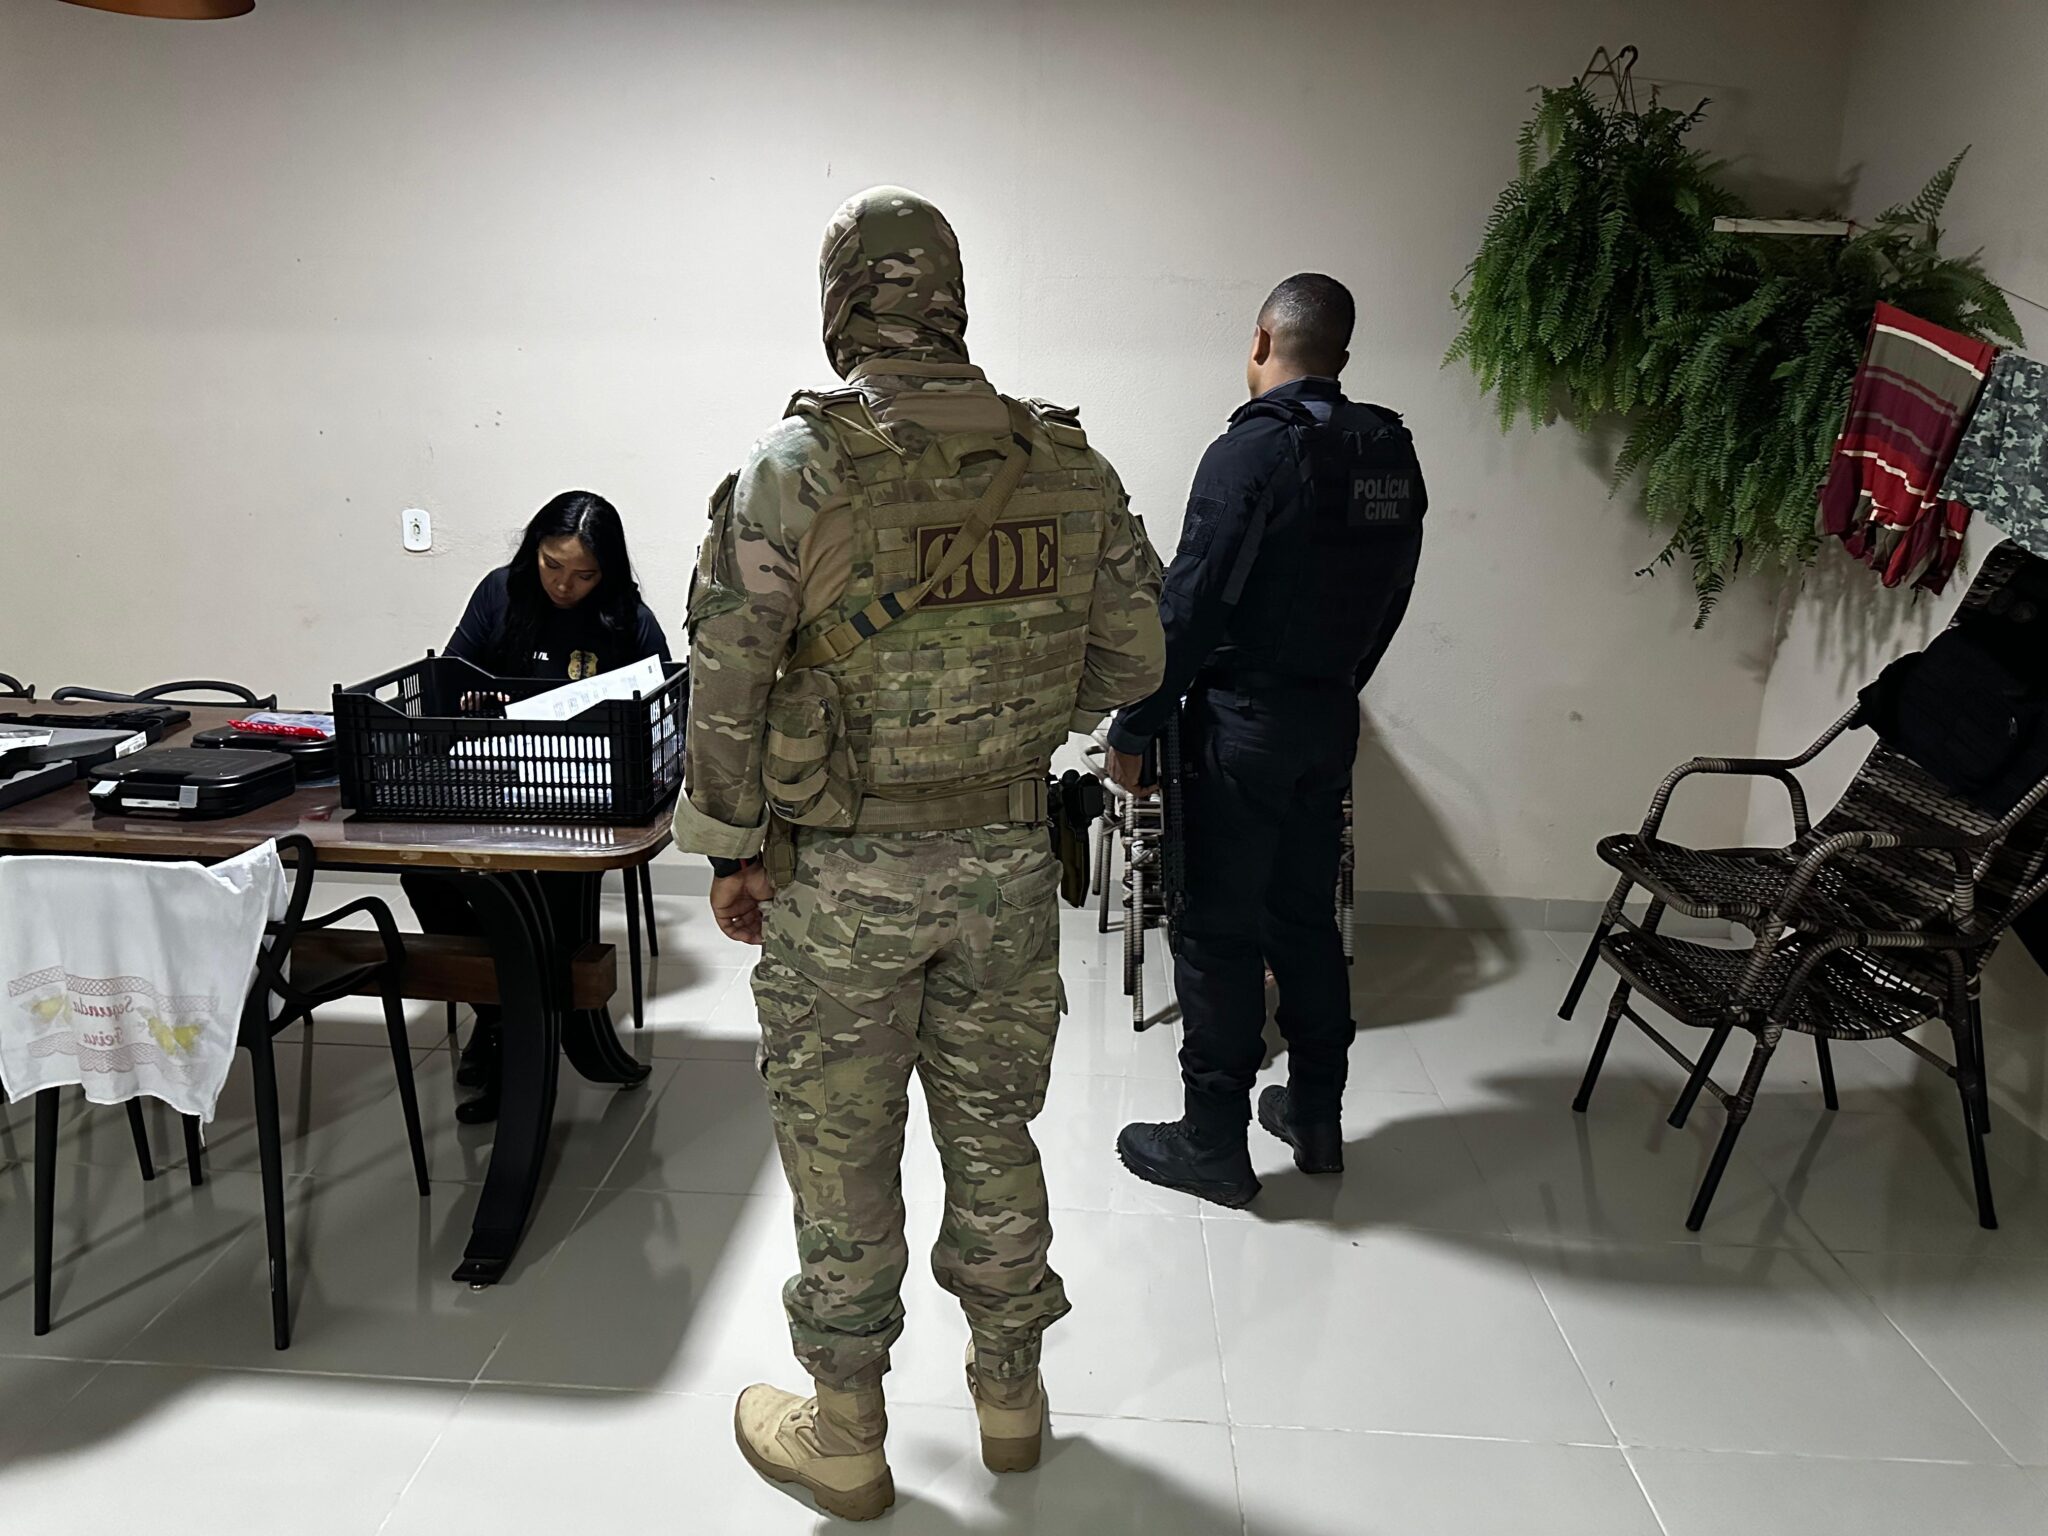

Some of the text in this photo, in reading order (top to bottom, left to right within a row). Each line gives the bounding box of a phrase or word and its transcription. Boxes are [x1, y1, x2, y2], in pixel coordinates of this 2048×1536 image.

[1353, 473, 1410, 500] POLÍCIA
[1364, 501, 1400, 521] CIVIL
[924, 525, 1055, 600] GOE
